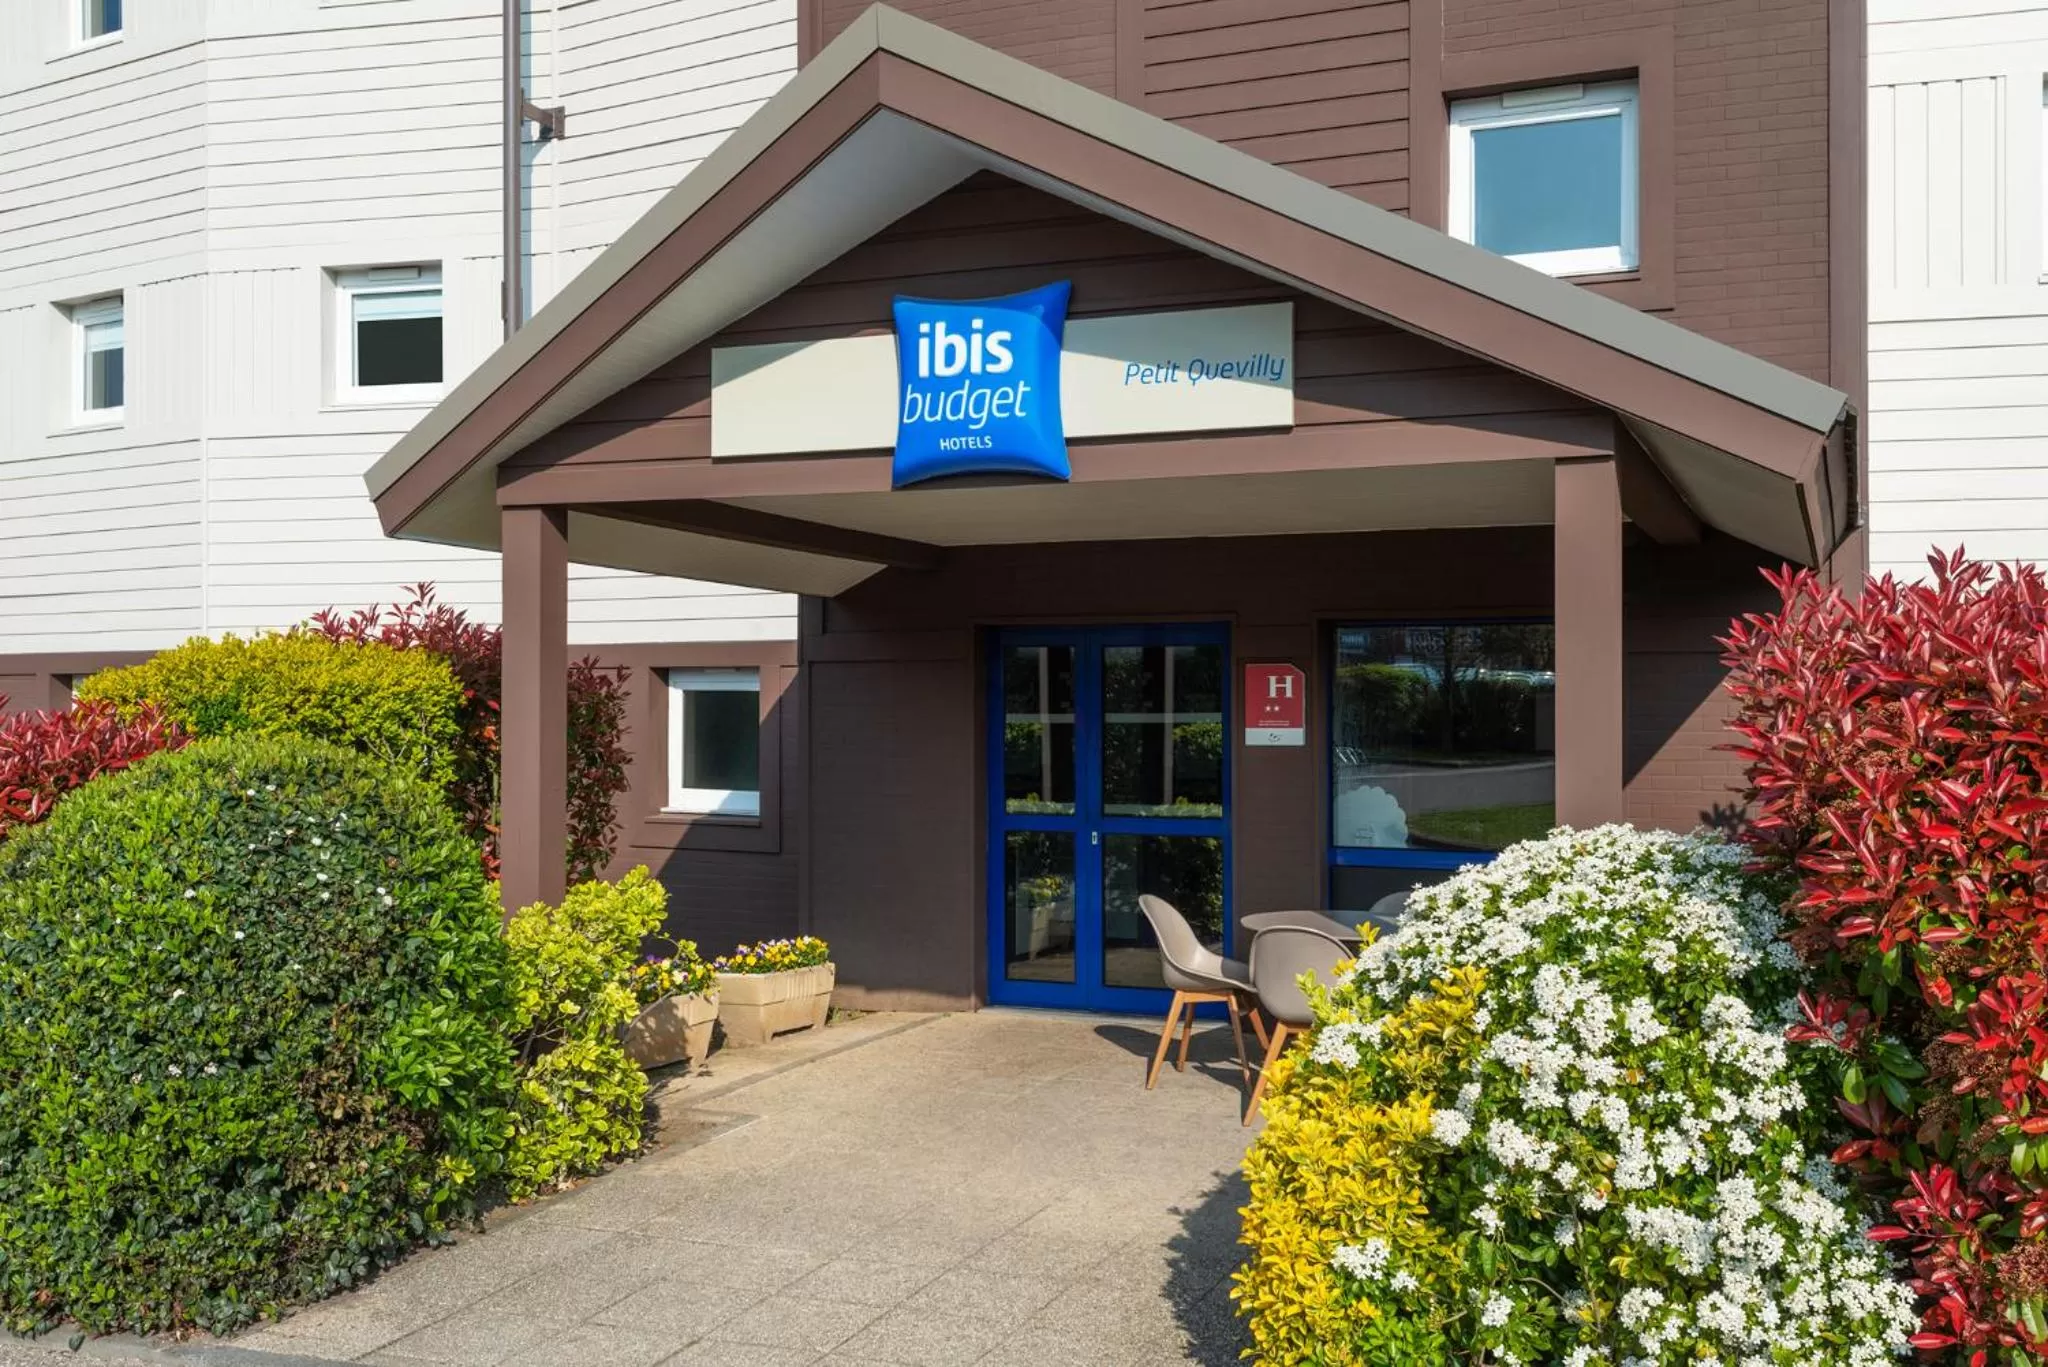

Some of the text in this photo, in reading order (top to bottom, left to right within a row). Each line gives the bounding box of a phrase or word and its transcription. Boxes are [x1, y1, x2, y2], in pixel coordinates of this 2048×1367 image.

[918, 319, 1013, 378] ibis
[1124, 353, 1285, 386] Petit Quevilly
[902, 380, 1031, 429] budget
[939, 435, 992, 452] HOTELS
[1267, 675, 1295, 698] H
